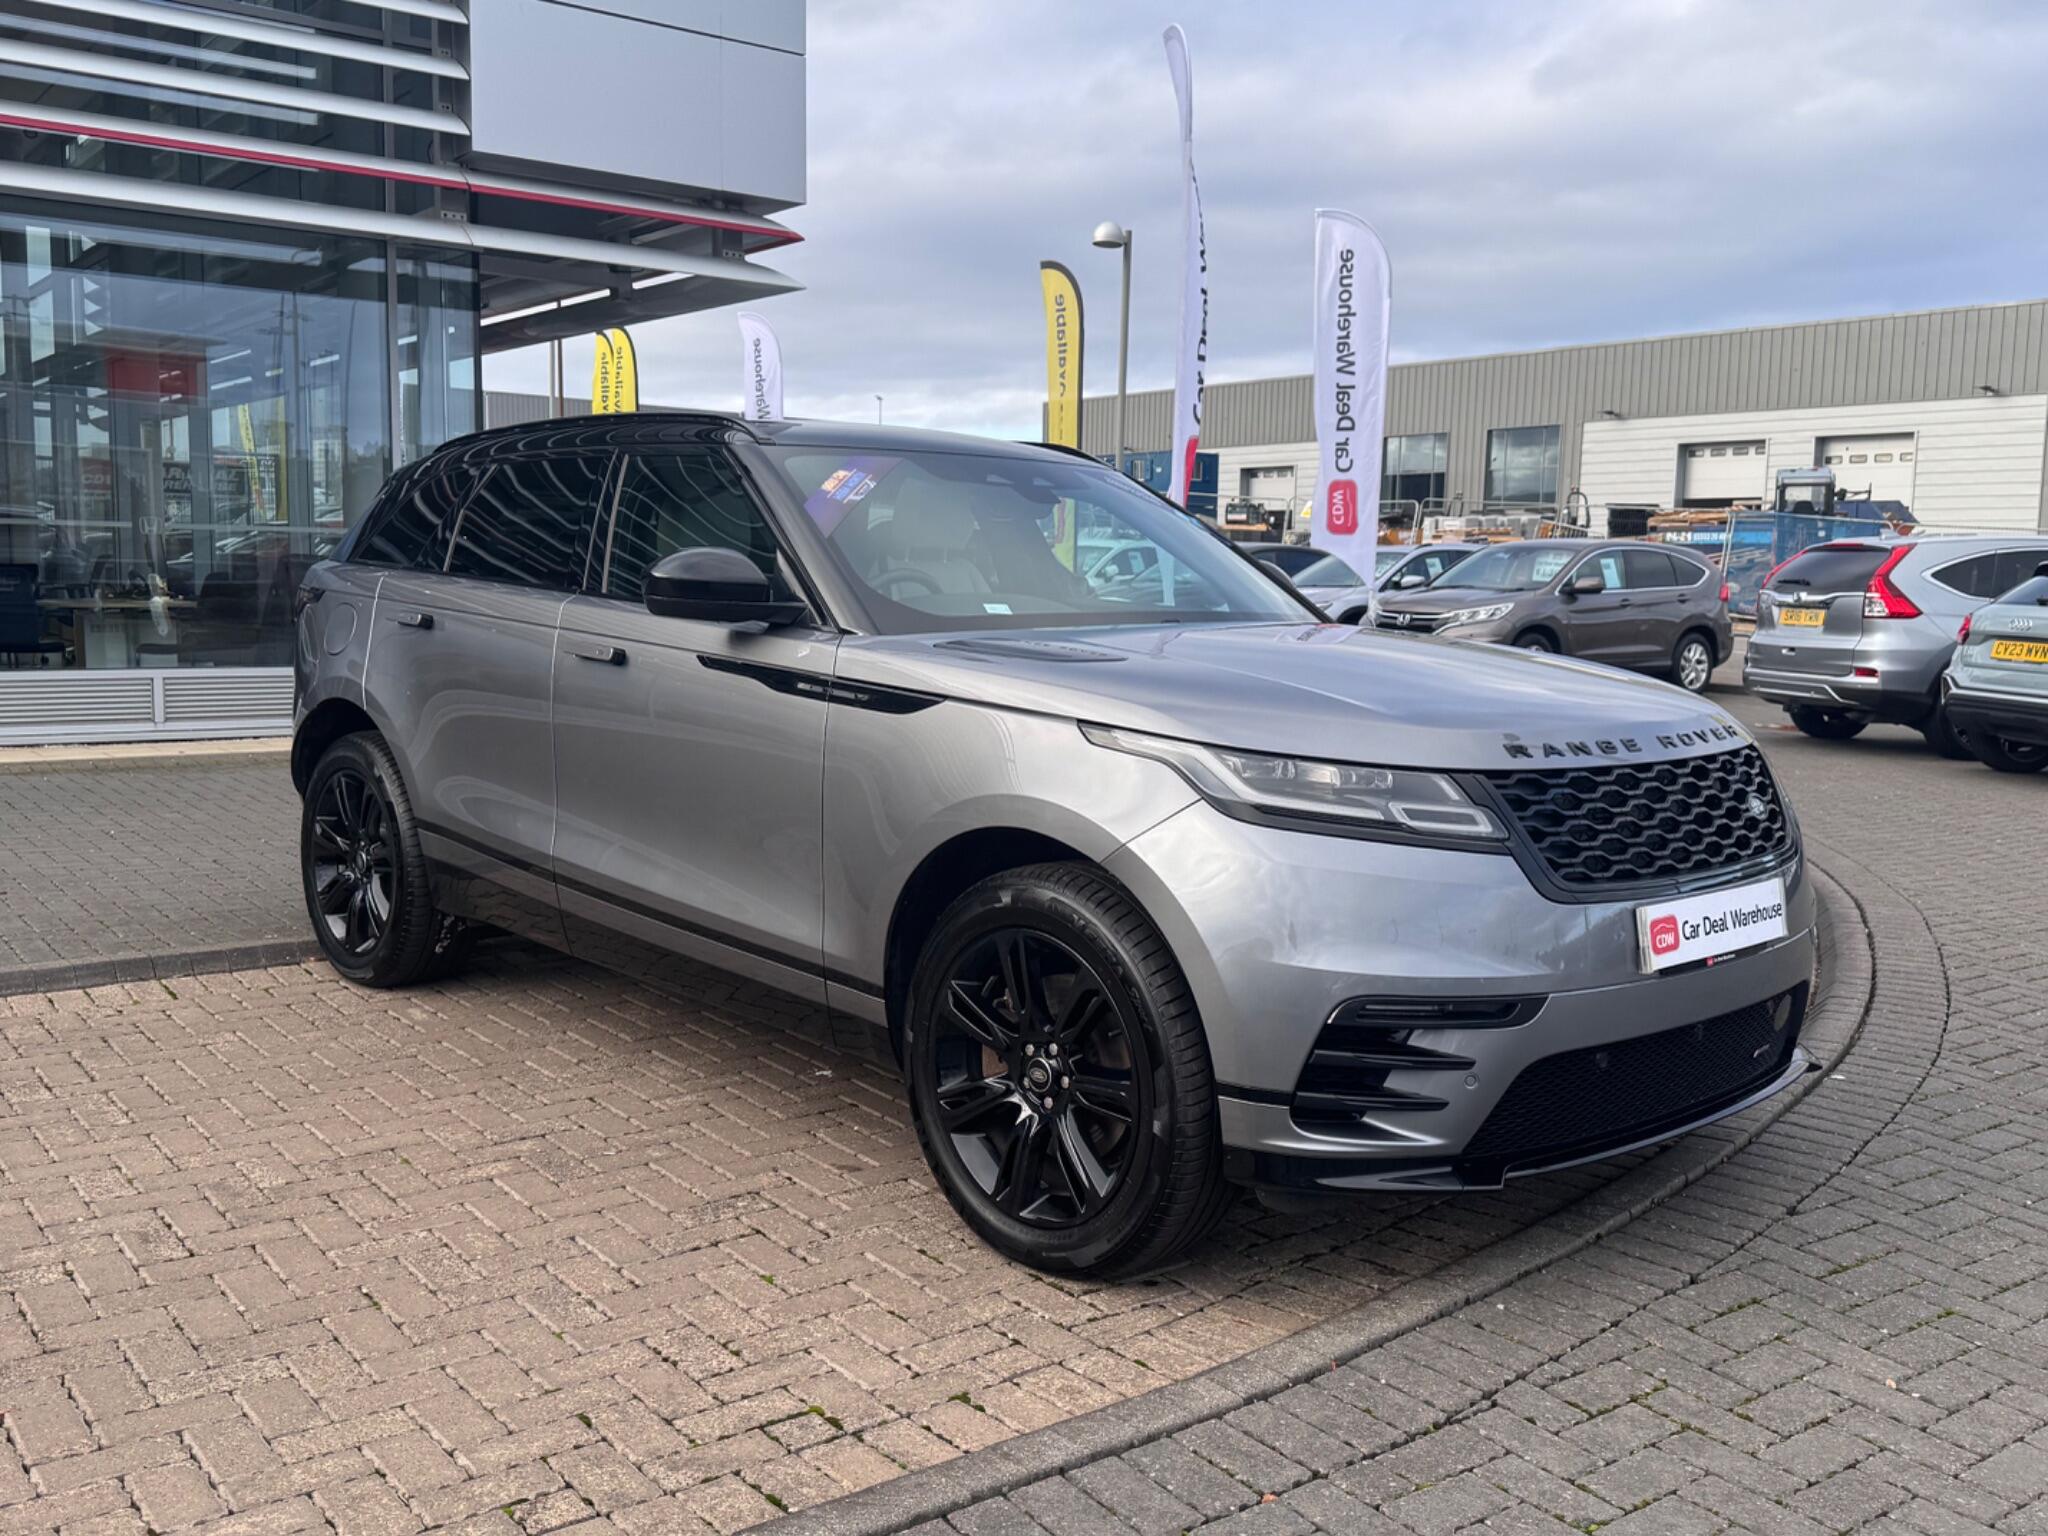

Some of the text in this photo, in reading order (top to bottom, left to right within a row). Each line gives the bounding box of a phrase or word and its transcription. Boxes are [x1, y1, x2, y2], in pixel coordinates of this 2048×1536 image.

[1502, 724, 1738, 759] RANGE ROVER
[1681, 902, 1783, 941] Car Deal Warehouse
[1655, 931, 1675, 949] CDW
